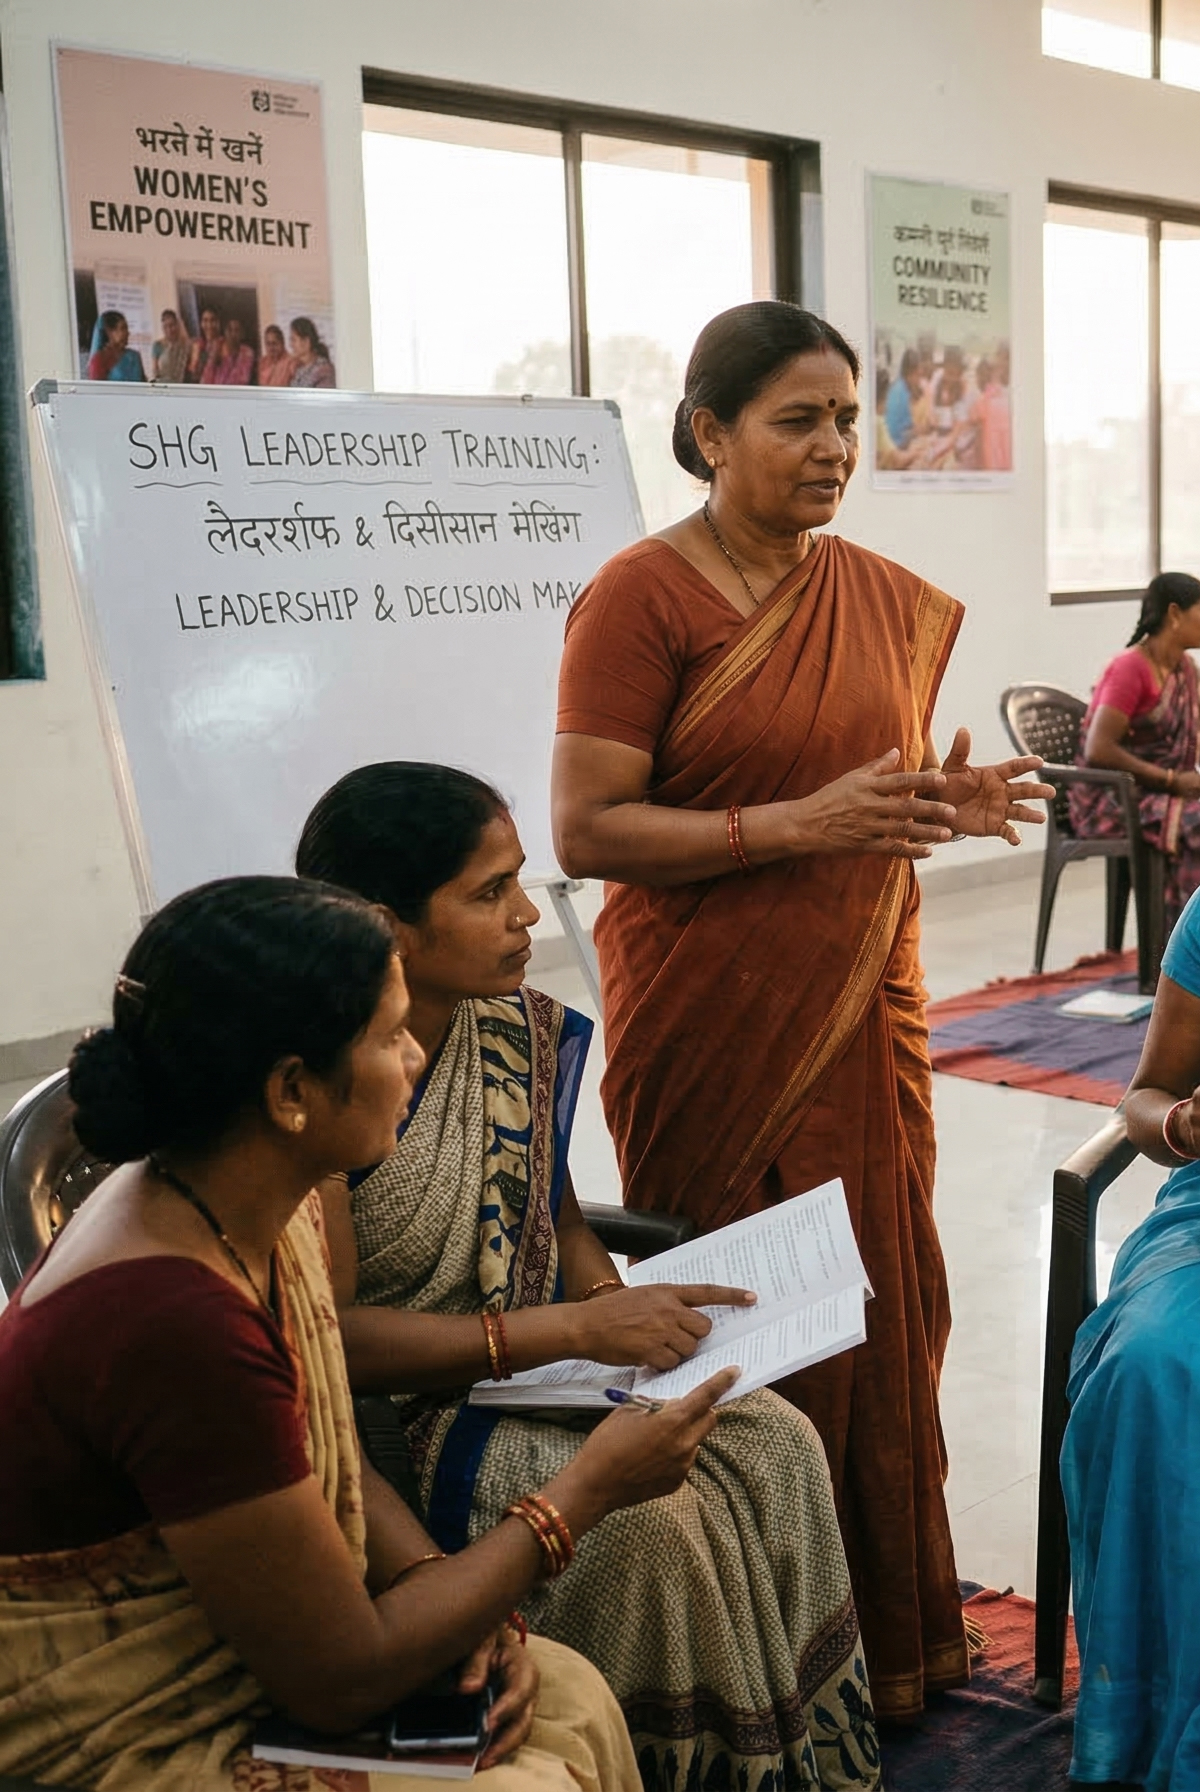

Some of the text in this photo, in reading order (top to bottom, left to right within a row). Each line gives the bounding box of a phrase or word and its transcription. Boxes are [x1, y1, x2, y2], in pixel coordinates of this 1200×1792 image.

[194, 126, 214, 160] में
[134, 165, 268, 207] WOMEN'S
[90, 200, 311, 249] EMPOWERMENT
[893, 255, 991, 285] COMMUNITY
[898, 284, 988, 313] RESILIENCE
[128, 422, 600, 475] SHG LEADERSHIP TRAINING:
[355, 516, 375, 550] &
[175, 587, 359, 630] LEADERSHIP
[374, 584, 397, 623] &
[404, 582, 522, 618] DECISION
